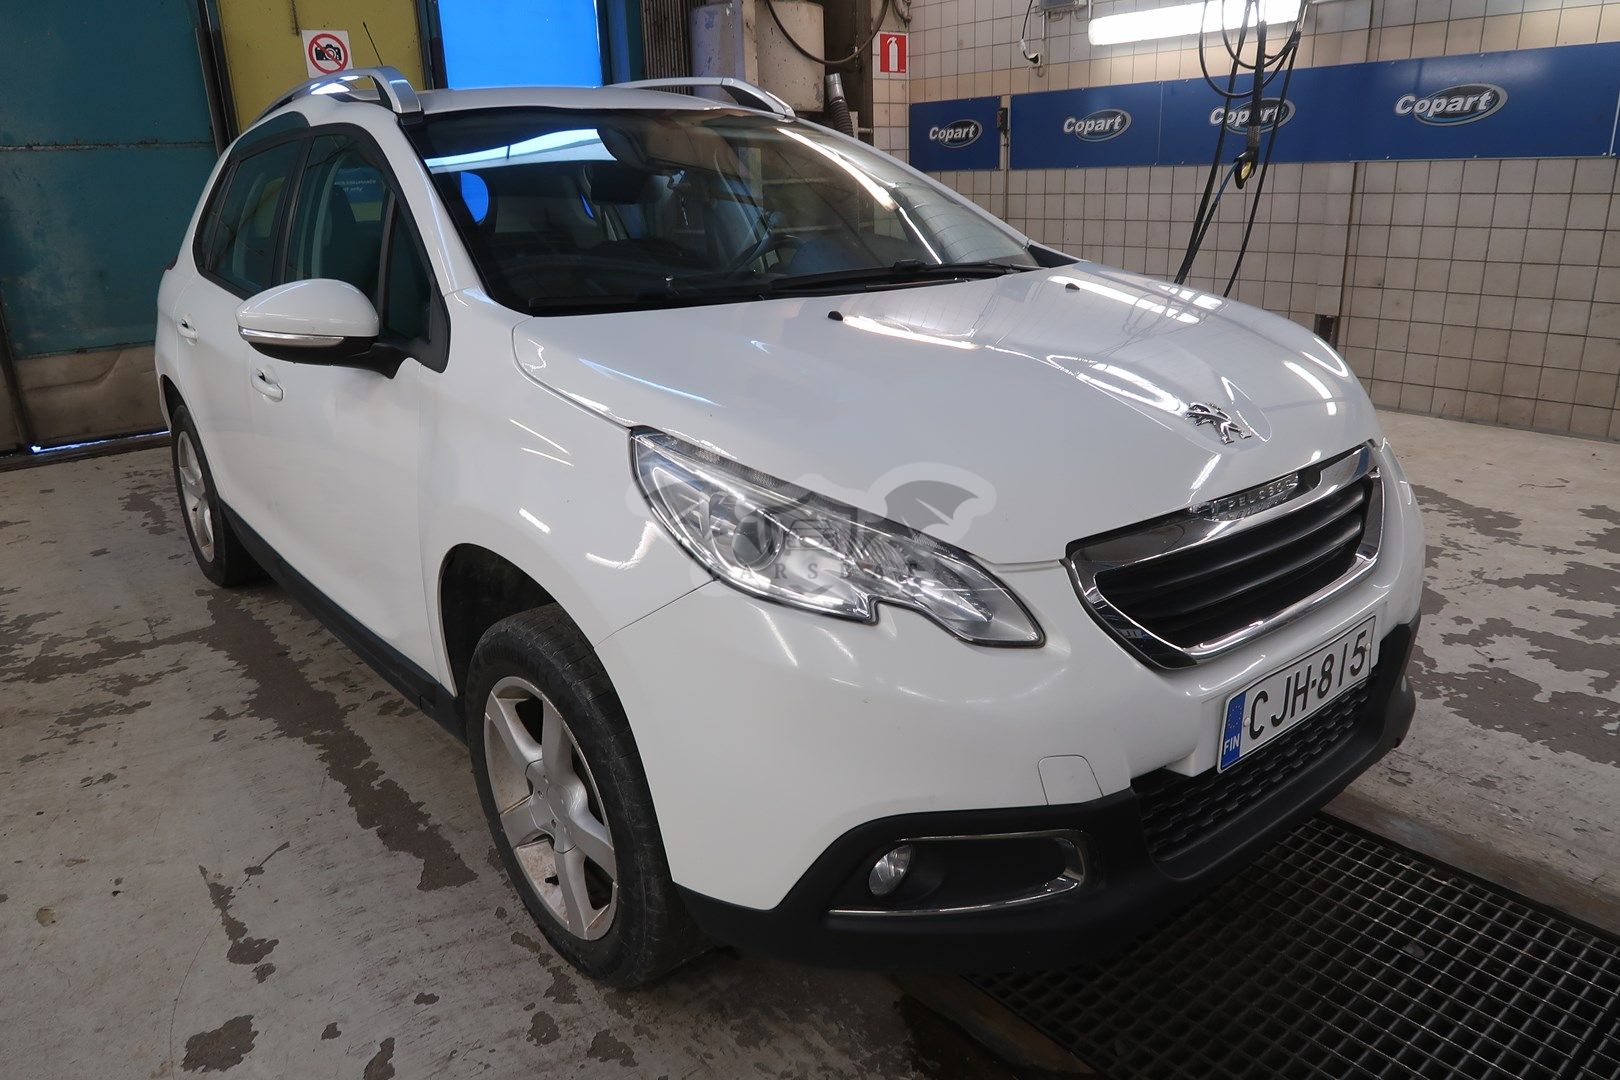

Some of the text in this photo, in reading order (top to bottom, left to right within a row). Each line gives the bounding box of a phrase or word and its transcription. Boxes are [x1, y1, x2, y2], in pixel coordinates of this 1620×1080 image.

[1210, 104, 1284, 127] Coprt
[1395, 91, 1492, 118] Copart
[929, 125, 976, 142] Copart
[1063, 115, 1122, 135] Copart
[1249, 629, 1367, 740] CJH-815
[1224, 733, 1240, 754] FIN
